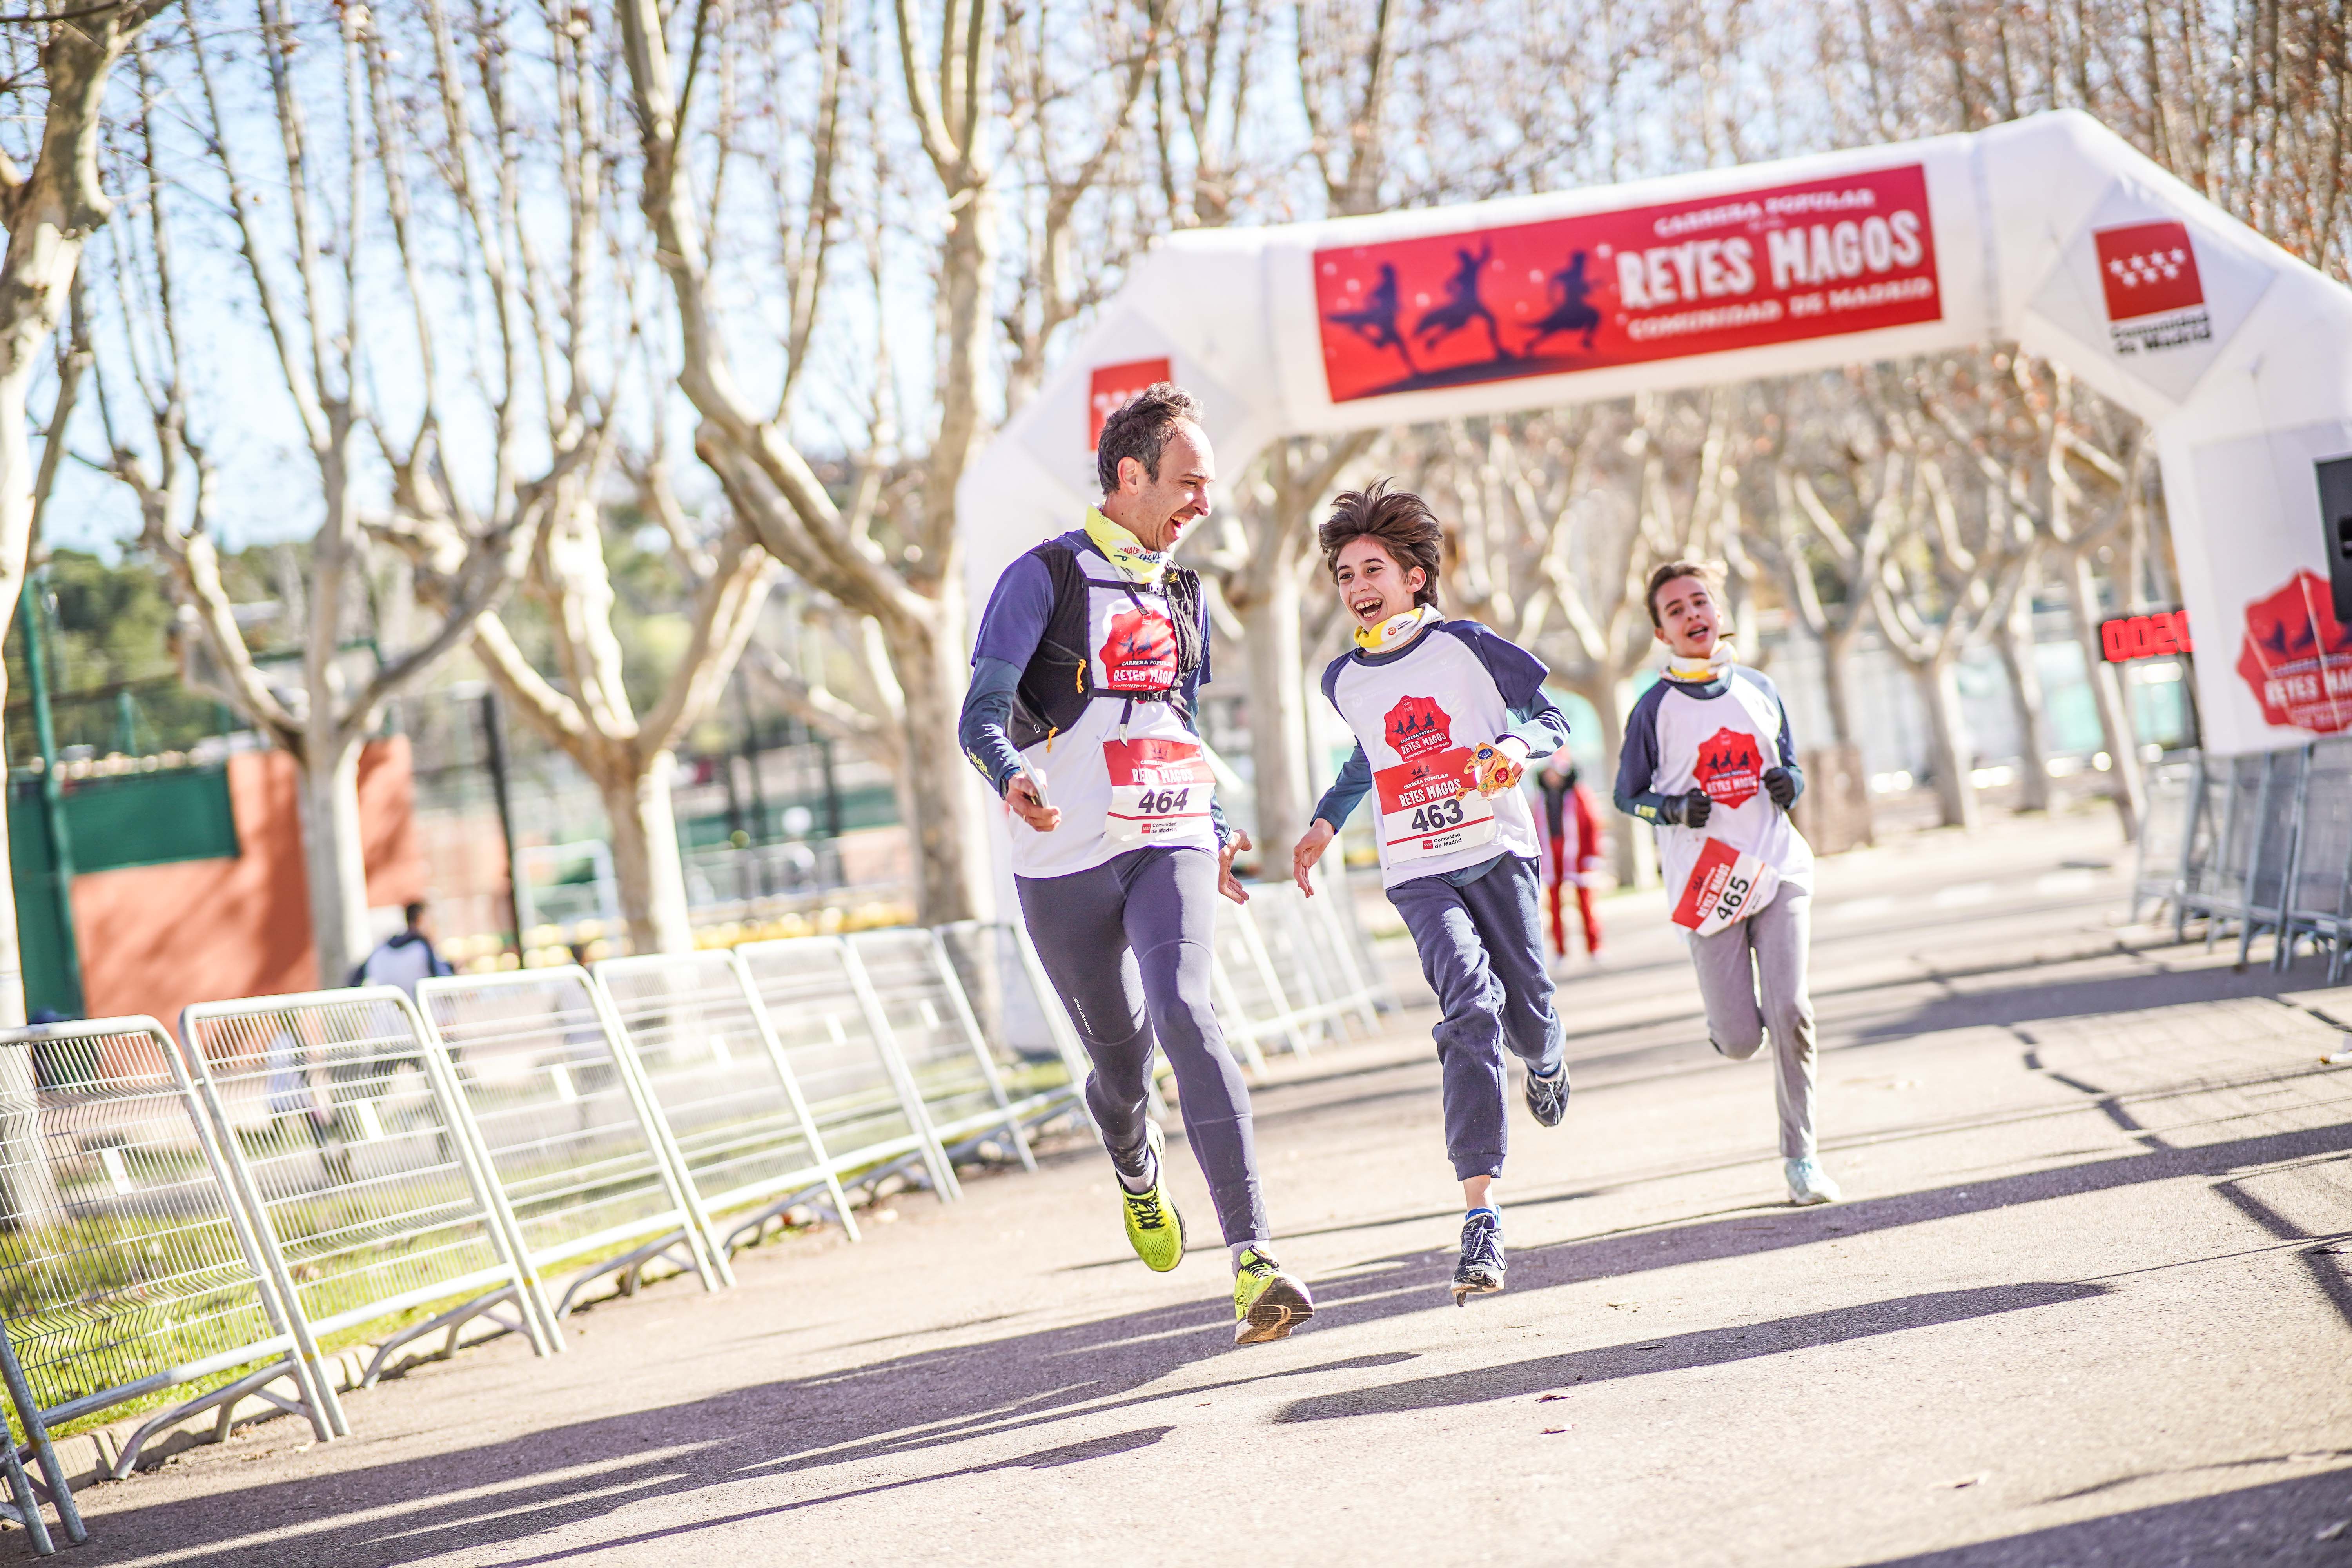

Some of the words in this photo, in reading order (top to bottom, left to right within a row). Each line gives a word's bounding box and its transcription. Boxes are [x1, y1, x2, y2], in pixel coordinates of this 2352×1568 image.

[1765, 189, 1875, 214] POPULAR
[1616, 237, 1756, 310] REYES
[1768, 210, 1922, 290] MAGOS
[1628, 299, 1783, 341] COMUNIDAD
[1789, 293, 1824, 317] DE
[1829, 277, 1934, 309] MADRID
[1114, 670, 1146, 681] REYES
[1149, 669, 1176, 684] MAGO
[1401, 734, 1419, 744] CARRERA
[1401, 740, 1421, 755] REYES
[1422, 732, 1446, 746] MAGOS
[1405, 749, 1426, 760] COMUNIDAD
[1160, 768, 1194, 783] MAGOS
[1403, 779, 1424, 789] CARRERA
[1424, 773, 1449, 782] POPULAR
[1138, 788, 1189, 813] 464
[1399, 789, 1426, 807] REYES
[1426, 778, 1462, 800] MAGOS
[1412, 799, 1463, 832] 463
[1434, 832, 1460, 843] Comunidad
[1444, 838, 1462, 847] Madrid
[1717, 875, 1749, 920] 465
[1073, 997, 1093, 1036] SALOMON
